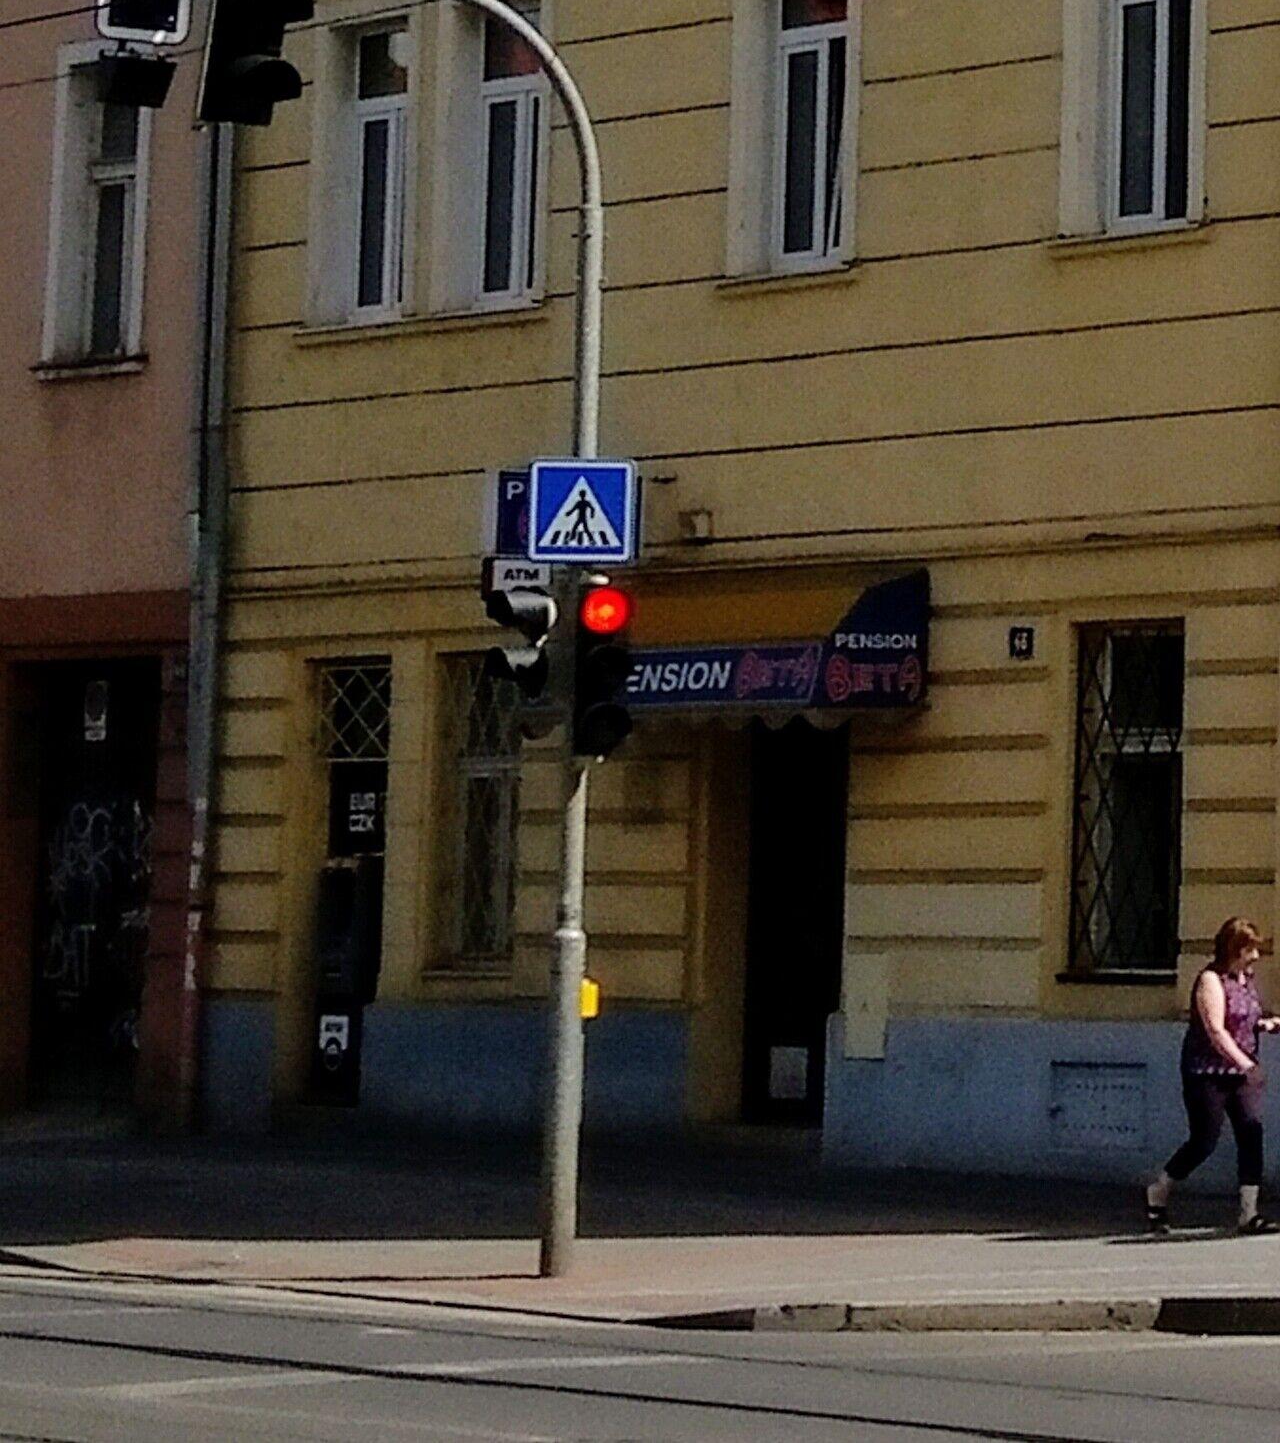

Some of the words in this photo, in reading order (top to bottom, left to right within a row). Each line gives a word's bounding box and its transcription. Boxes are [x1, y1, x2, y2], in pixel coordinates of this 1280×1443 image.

[503, 568, 541, 582] ATM
[834, 632, 918, 650] PENSION
[626, 661, 732, 693] ENSION
[350, 792, 376, 810] EUR
[349, 814, 376, 832] CZK
